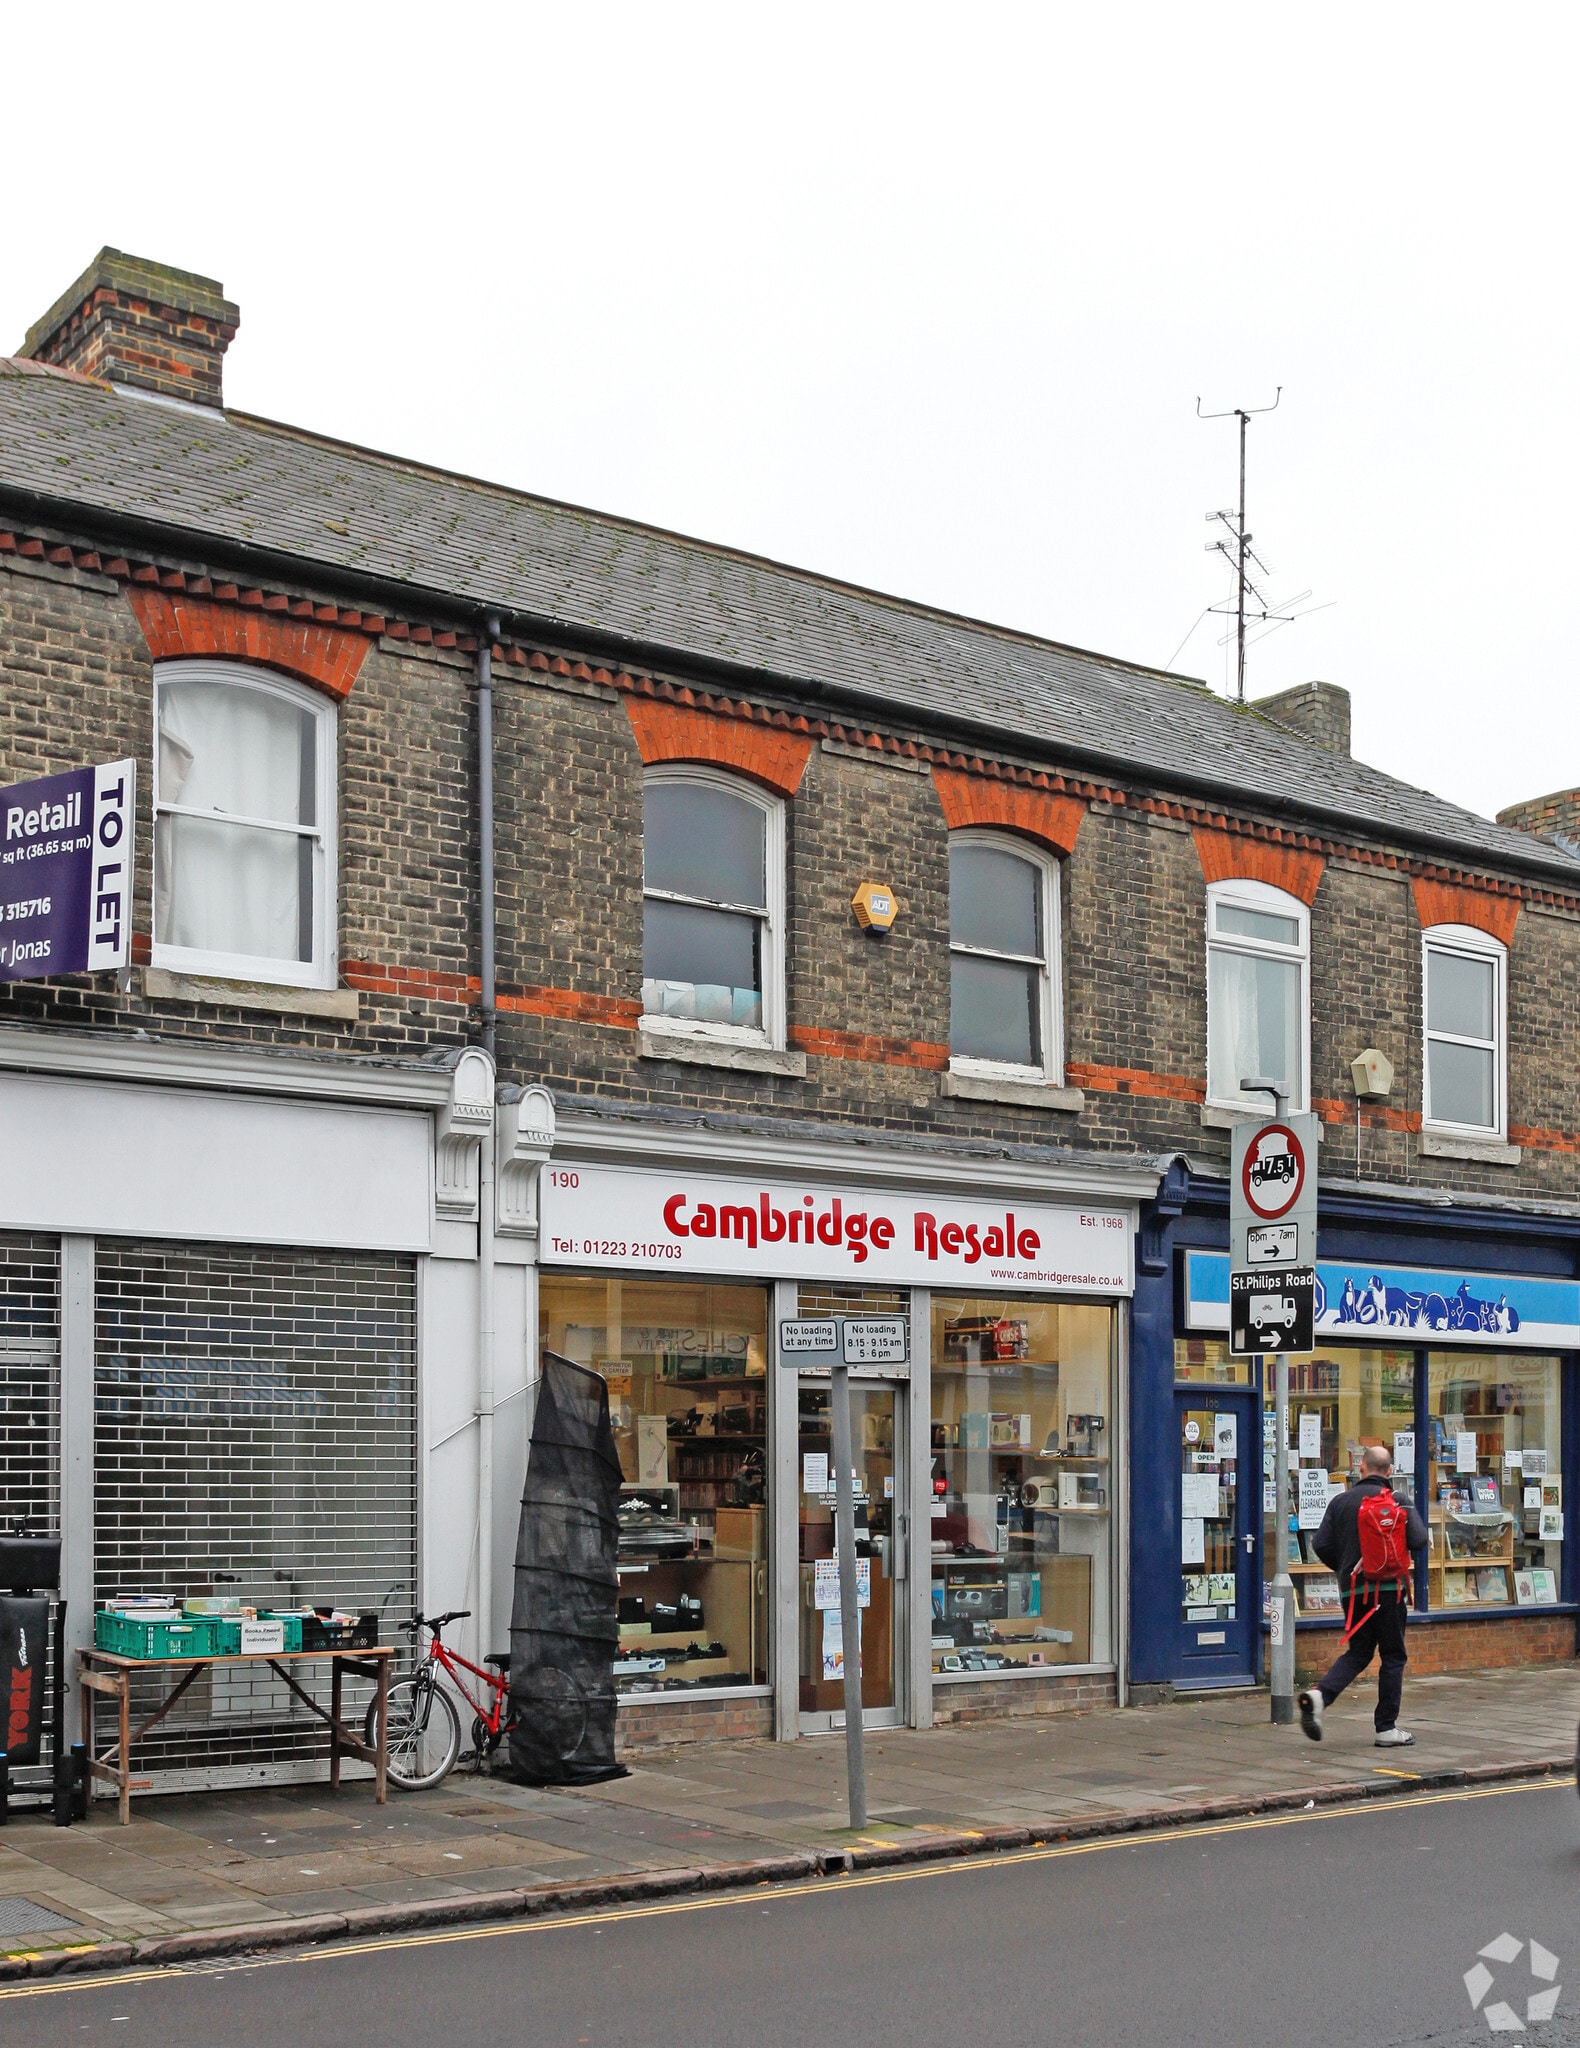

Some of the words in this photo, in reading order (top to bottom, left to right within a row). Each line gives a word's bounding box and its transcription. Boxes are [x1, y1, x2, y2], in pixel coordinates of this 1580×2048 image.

[6, 791, 82, 841] Retail
[98, 777, 124, 848] TO
[2, 852, 15, 865] sq
[16, 847, 25, 861] ft
[26, 840, 59, 860] (36.65
[61, 841, 74, 854] sq
[76, 834, 92, 850] m)
[6, 897, 52, 921] 315716
[95, 863, 122, 952] LET
[871, 899, 890, 912] ADT
[8, 939, 52, 968] Jonas
[1265, 1157, 1284, 1175] 7.5
[1286, 1155, 1294, 1167] T
[550, 1171, 580, 1189] 190
[662, 1191, 896, 1264] Cambridge
[913, 1211, 1042, 1265] Resale
[1080, 1214, 1099, 1228] Est.
[1101, 1216, 1124, 1230] 1968
[1249, 1230, 1268, 1244] 6pm
[1278, 1229, 1296, 1240] 7am
[551, 1237, 579, 1254] Tel:
[583, 1239, 628, 1257] 01223
[631, 1242, 683, 1260] 210703
[990, 1267, 1124, 1287] www.cambridgeresale.co.uk
[1285, 1271, 1314, 1287] Road
[786, 1326, 799, 1335] No
[801, 1325, 833, 1336] loading
[852, 1325, 864, 1334] No
[866, 1324, 897, 1335] loading
[785, 1338, 795, 1346] at
[797, 1339, 812, 1347] any
[815, 1337, 834, 1346] time
[847, 1338, 865, 1348] 8.15
[871, 1338, 888, 1347] 9.15
[889, 1339, 902, 1347] am
[859, 1349, 865, 1358] 5
[871, 1349, 877, 1357] 6
[878, 1350, 891, 1359] pm
[1300, 1497, 1327, 1510] CLEARANCES
[1478, 1492, 1495, 1500] WHO
[18, 1627, 29, 1667] Fitness
[6, 1665, 33, 1751] YORK
